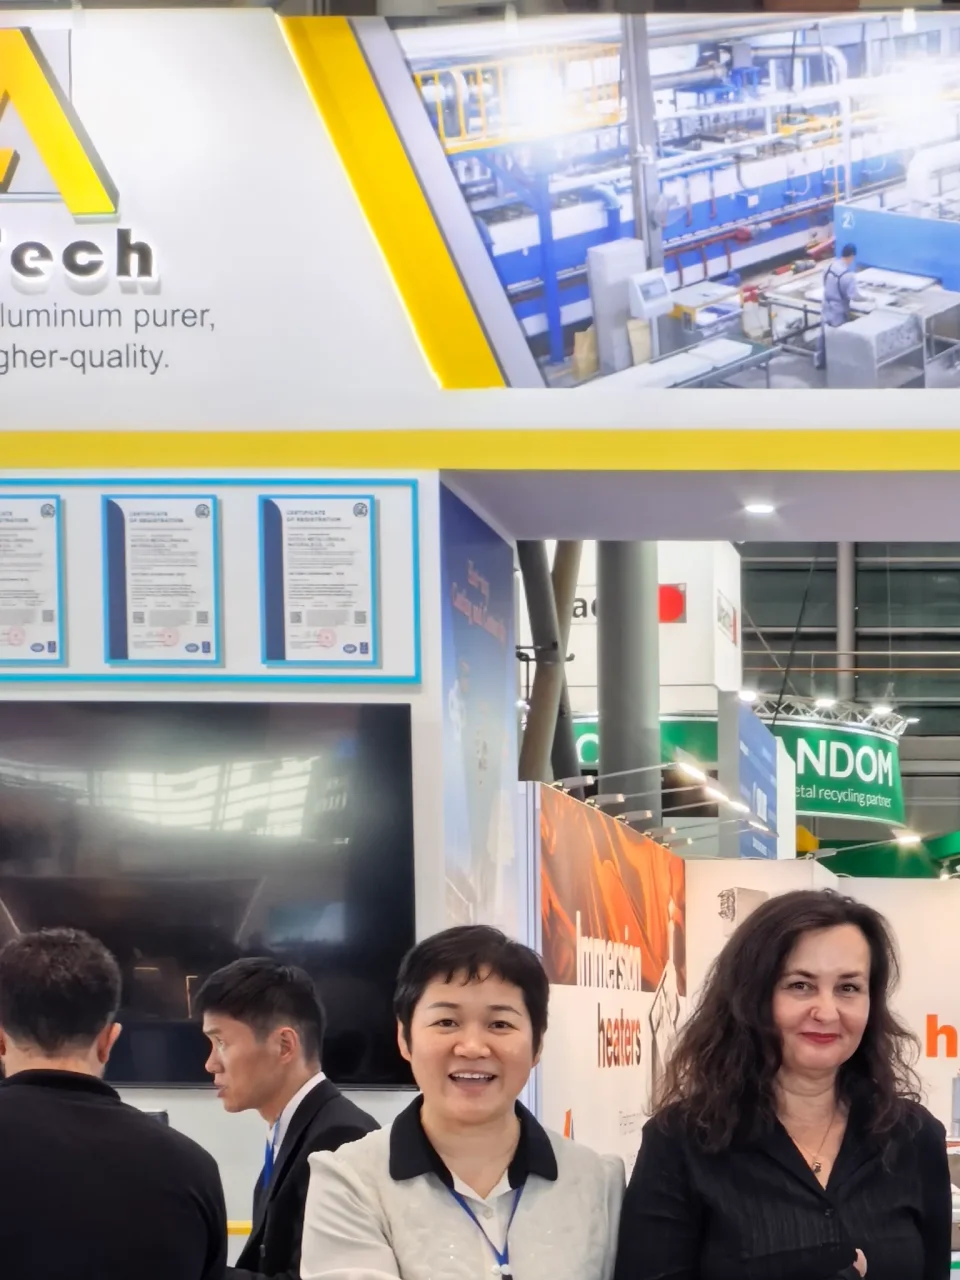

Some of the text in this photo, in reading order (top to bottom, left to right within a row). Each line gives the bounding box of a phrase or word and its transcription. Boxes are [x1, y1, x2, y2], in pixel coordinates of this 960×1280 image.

[0, 228, 153, 277] ech
[134, 307, 215, 334] purer,
[818, 787, 865, 807] recycling
[866, 794, 892, 808] partner
[598, 1002, 641, 1069] heaters
